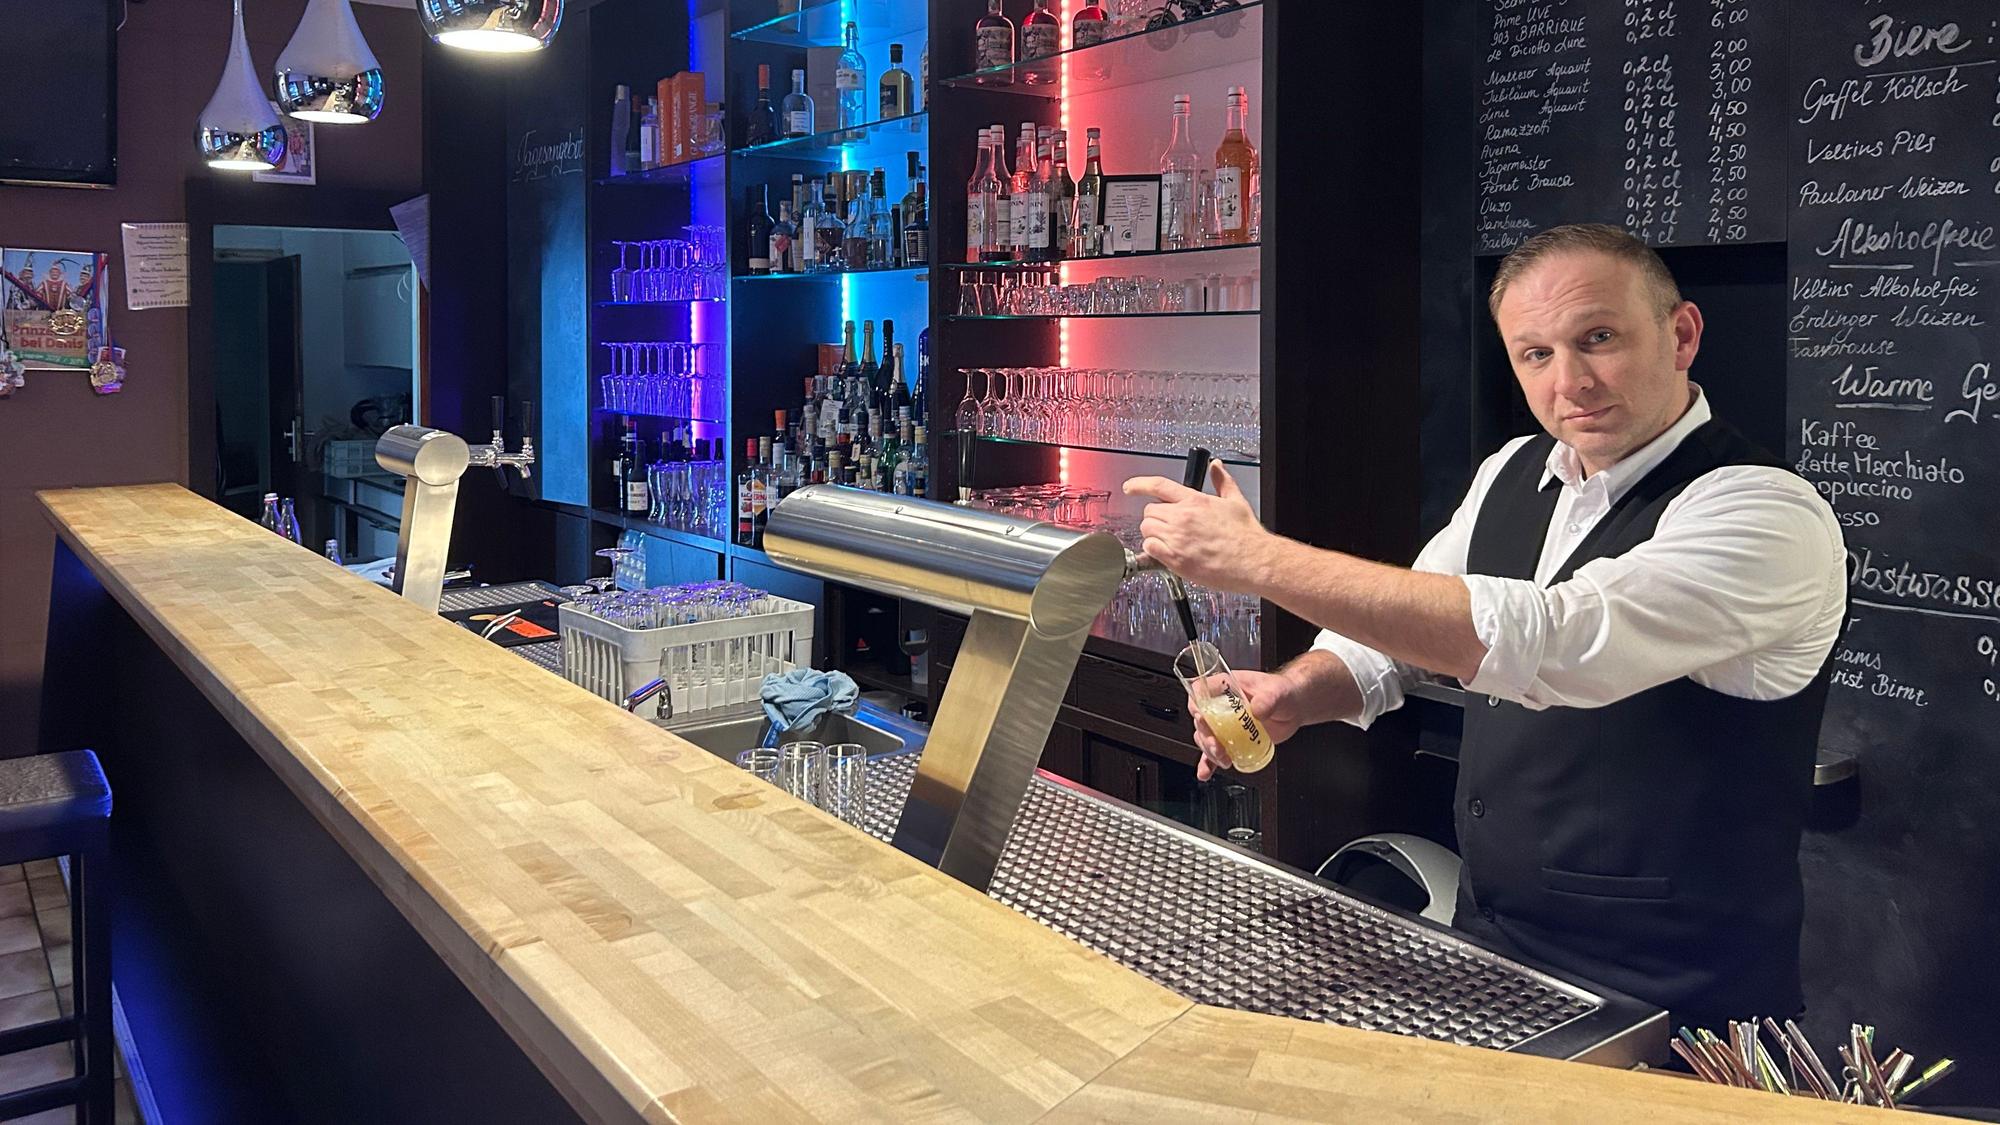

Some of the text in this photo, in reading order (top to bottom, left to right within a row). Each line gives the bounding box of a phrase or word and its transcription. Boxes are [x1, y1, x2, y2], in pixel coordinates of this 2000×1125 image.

[1624, 7, 1655, 27] 0,2
[1658, 1, 1678, 20] cl
[1626, 24, 1655, 44] 0,2
[1711, 8, 1749, 29] 6,00
[1854, 14, 1972, 67] Biere
[1483, 38, 1748, 86] Malteser Aquavit 0,2 cl 2,00
[1482, 84, 1540, 105] Jubiläum
[1543, 78, 1590, 104] Aquavit
[1626, 75, 1655, 96] 0,2
[1709, 57, 1752, 80] 3,00
[1538, 98, 1587, 120] Aquavit
[1624, 94, 1654, 114] 0,2
[1660, 92, 1679, 108] cl
[1712, 77, 1752, 100] 3,00
[1798, 78, 1874, 124] Gaffel
[1880, 66, 1969, 104] Kölsch
[1485, 100, 1748, 141] Ramazzotti 0,4 cl 4,50
[1481, 122, 1747, 160] Averna 0,4 cl 4,50
[1807, 130, 1936, 164] Veltins Pils
[1479, 144, 1747, 186] Jägermeister 0,2 cl 2,50
[1624, 174, 1657, 194] 0,2
[1662, 169, 1682, 189] cl
[1710, 165, 1747, 186] 2,50
[1480, 188, 1748, 215] Ouzo 0,2 cl 2,00
[1799, 176, 1970, 208] Paulaner Weizen
[1477, 206, 1747, 231] Sambuca 0,2 cl 2,50
[1658, 225, 1674, 244] cl
[1707, 225, 1747, 244] 4,50
[1815, 217, 1996, 277] Alkoholfreie
[1793, 277, 1854, 301] Veltins
[1789, 304, 1985, 342] Erdinger Weizen
[1832, 364, 1934, 401] Warme
[1801, 418, 1880, 450] Kaffee
[1795, 448, 1965, 484] Latte Macchiato
